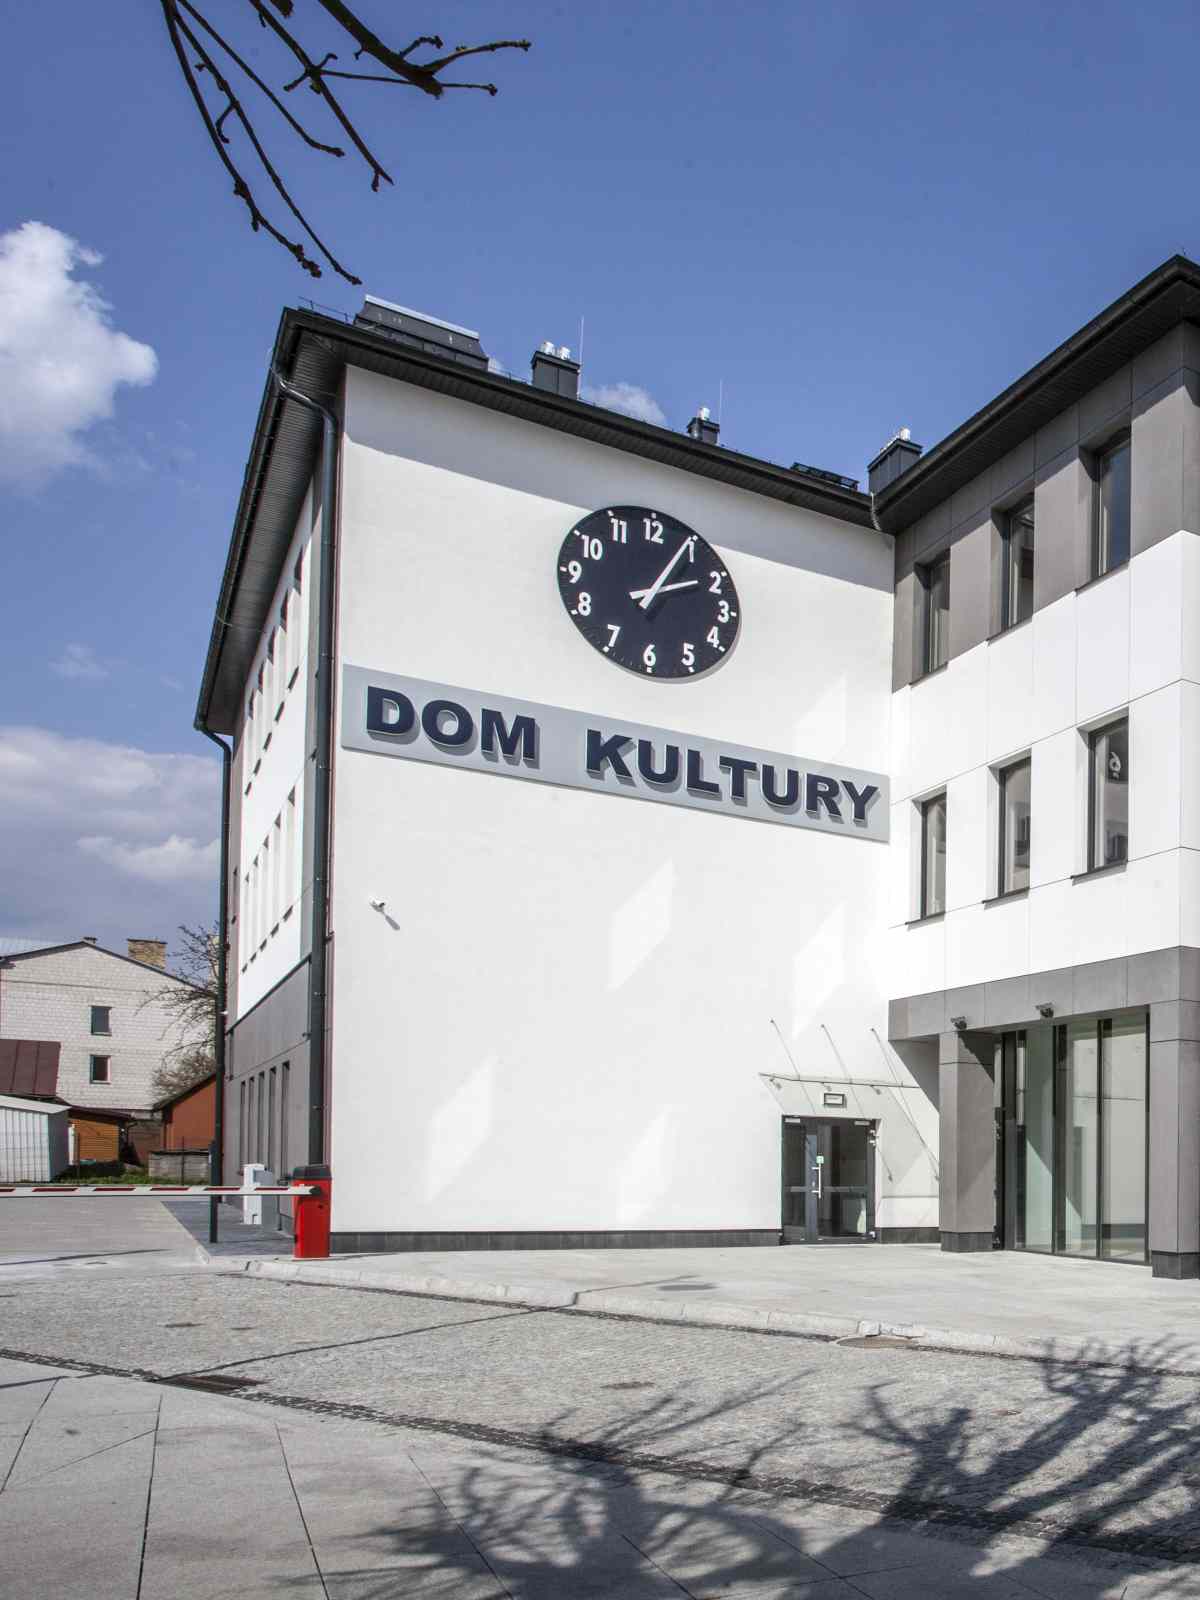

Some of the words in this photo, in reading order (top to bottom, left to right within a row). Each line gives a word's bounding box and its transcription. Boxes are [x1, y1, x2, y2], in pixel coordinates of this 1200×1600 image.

[611, 517, 627, 544] 11
[643, 517, 664, 545] 12
[581, 534, 603, 561] 10
[688, 540, 695, 563] 1
[567, 560, 582, 584] 9
[708, 570, 722, 595] 2
[577, 591, 592, 617] 8
[717, 599, 730, 624] 3
[607, 623, 621, 648] 7
[706, 625, 720, 649] 4
[642, 643, 657, 667] 6
[681, 642, 695, 666] 5
[366, 685, 536, 761] DOM
[586, 729, 878, 823] KULTURY
